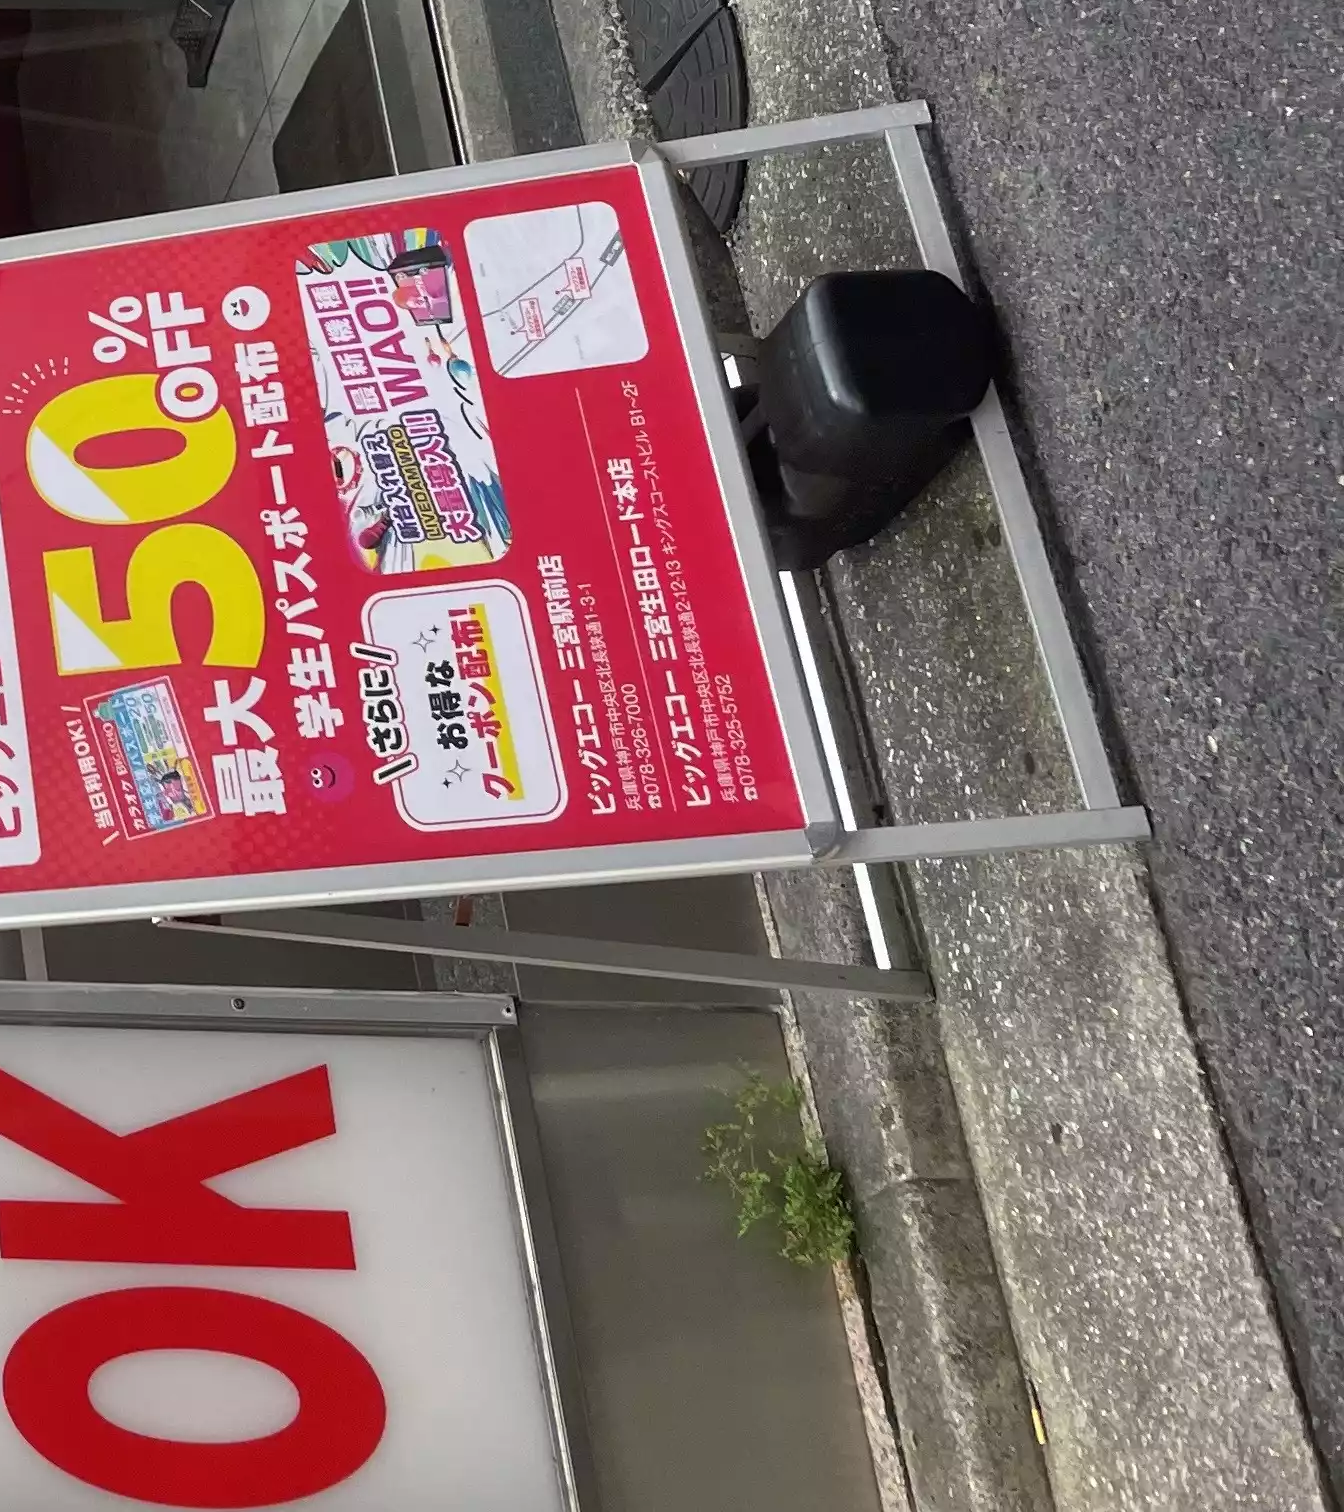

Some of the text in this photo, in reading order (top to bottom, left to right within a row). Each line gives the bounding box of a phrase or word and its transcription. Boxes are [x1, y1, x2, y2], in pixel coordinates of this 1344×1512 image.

[147, 288, 221, 419] OFF
[309, 282, 384, 412] 最新機種
[345, 276, 429, 407] WAO!!
[25, 373, 267, 676] 50
[232, 340, 346, 740] 学生パスポート配布
[634, 429, 678, 556] キングスコーストビル
[536, 554, 617, 816] ビッグエコー 三宮駅前店
[606, 457, 712, 808] ビッグエコー 三宮生田ロード本店
[203, 675, 287, 817] 最大
[362, 668, 404, 754] さらに
[424, 659, 468, 750] お得な
[447, 607, 515, 800] クーポン配布!
[620, 683, 660, 795] 078-326-7000
[714, 673, 756, 787] 078-325-5752
[65, 718, 115, 828] 当日利用OK!
